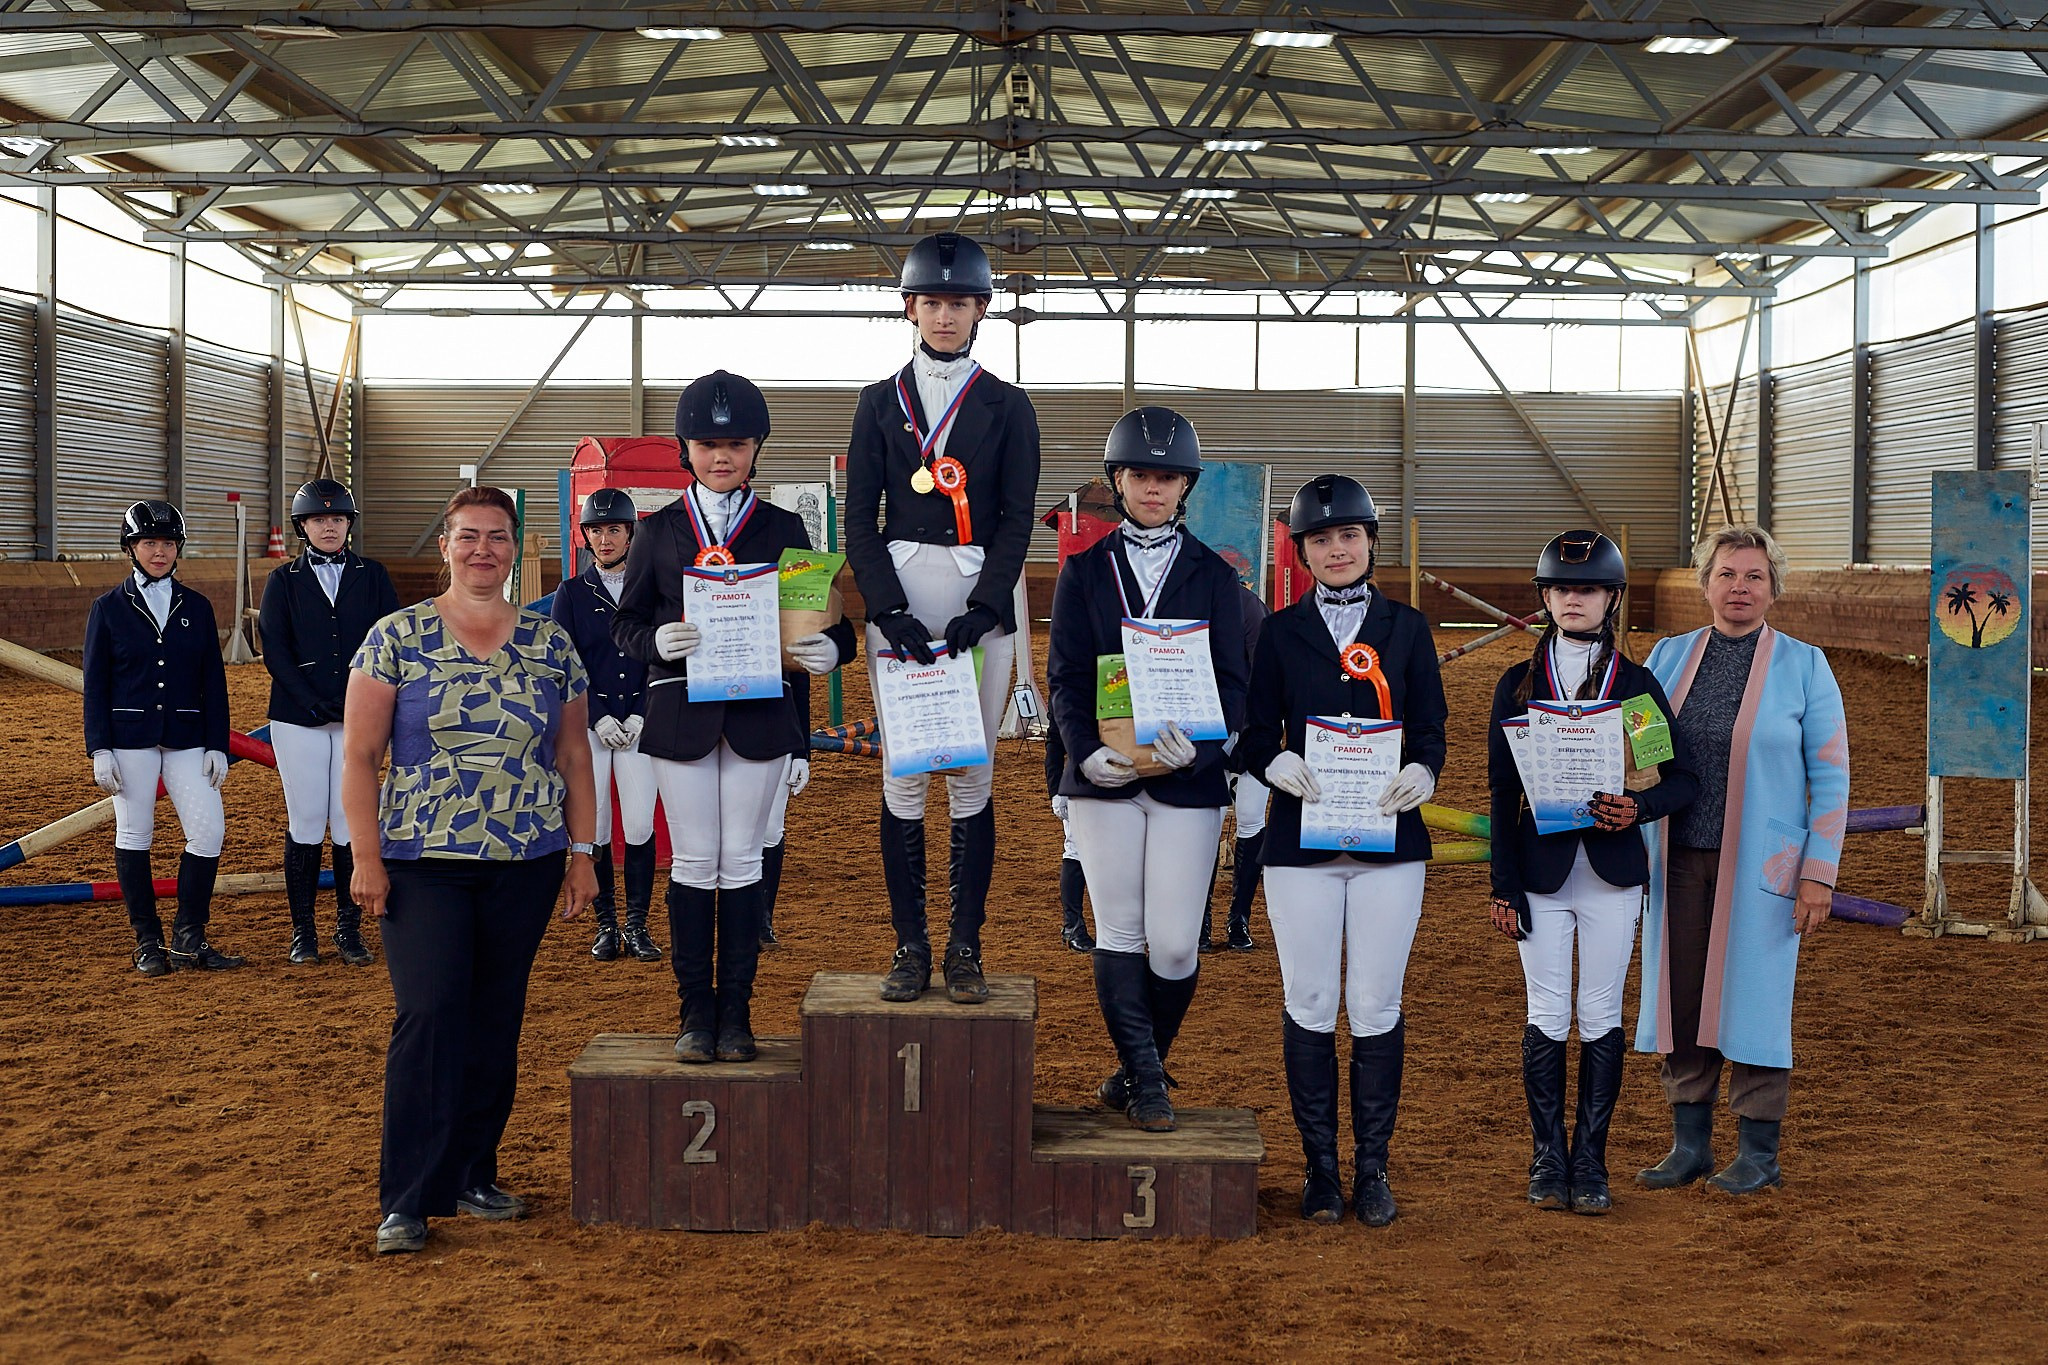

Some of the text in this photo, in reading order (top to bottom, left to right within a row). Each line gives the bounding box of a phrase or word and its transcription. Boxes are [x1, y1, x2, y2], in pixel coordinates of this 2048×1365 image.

[711, 593, 751, 601] ГРАМОТА
[1149, 647, 1186, 655] ГРАМОТА
[906, 669, 946, 680] ГРАМОТА
[1021, 692, 1032, 715] 1
[1333, 746, 1373, 754] ГРАМОТА
[897, 1043, 920, 1112] 1
[682, 1100, 717, 1163] 2
[1123, 1165, 1156, 1228] 3
